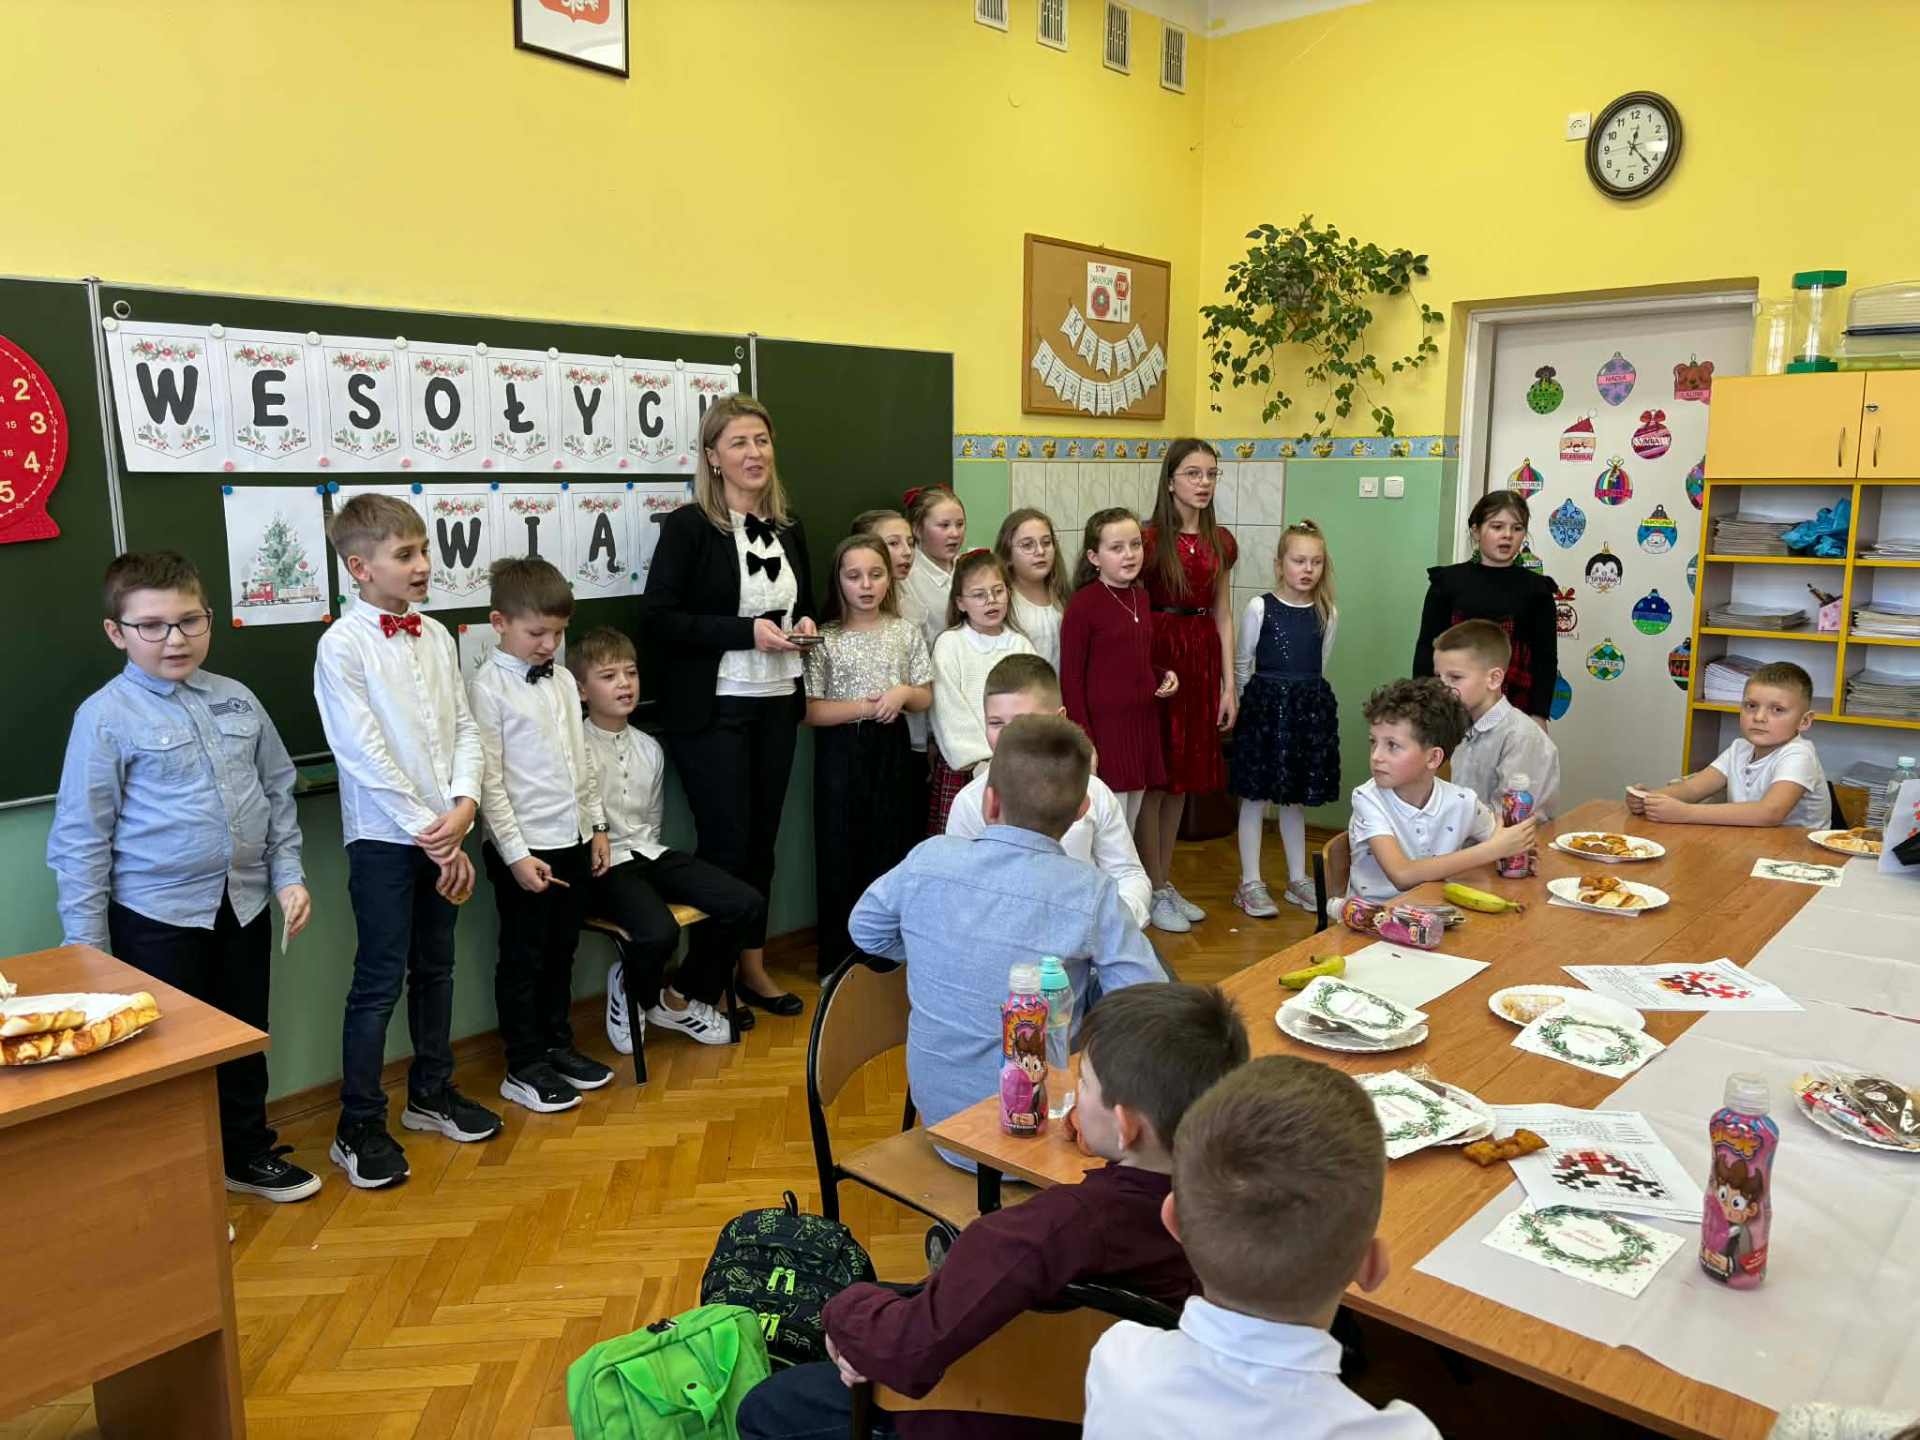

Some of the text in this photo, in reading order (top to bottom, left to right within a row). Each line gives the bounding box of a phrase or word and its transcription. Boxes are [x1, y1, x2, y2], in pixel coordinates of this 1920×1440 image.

[1630, 110, 1641, 120] 12
[1647, 113, 1653, 123] 1
[1616, 118, 1625, 127] 11
[1655, 125, 1661, 134] 2
[1607, 131, 1617, 141] 10
[1604, 145, 1610, 155] 9
[1651, 153, 1658, 162] 4
[1606, 160, 1612, 169] 8
[1614, 169, 1621, 178] 7
[1643, 165, 1649, 174] 5
[1628, 173, 1634, 182] 6
[12, 378, 30, 401] 2
[136, 362, 719, 439] WESOŁYC
[5, 421, 17, 430] 15
[30, 411, 47, 435] 3
[2, 449, 14, 458] 16
[23, 450, 41, 474] 4
[0, 480, 16, 504] 5
